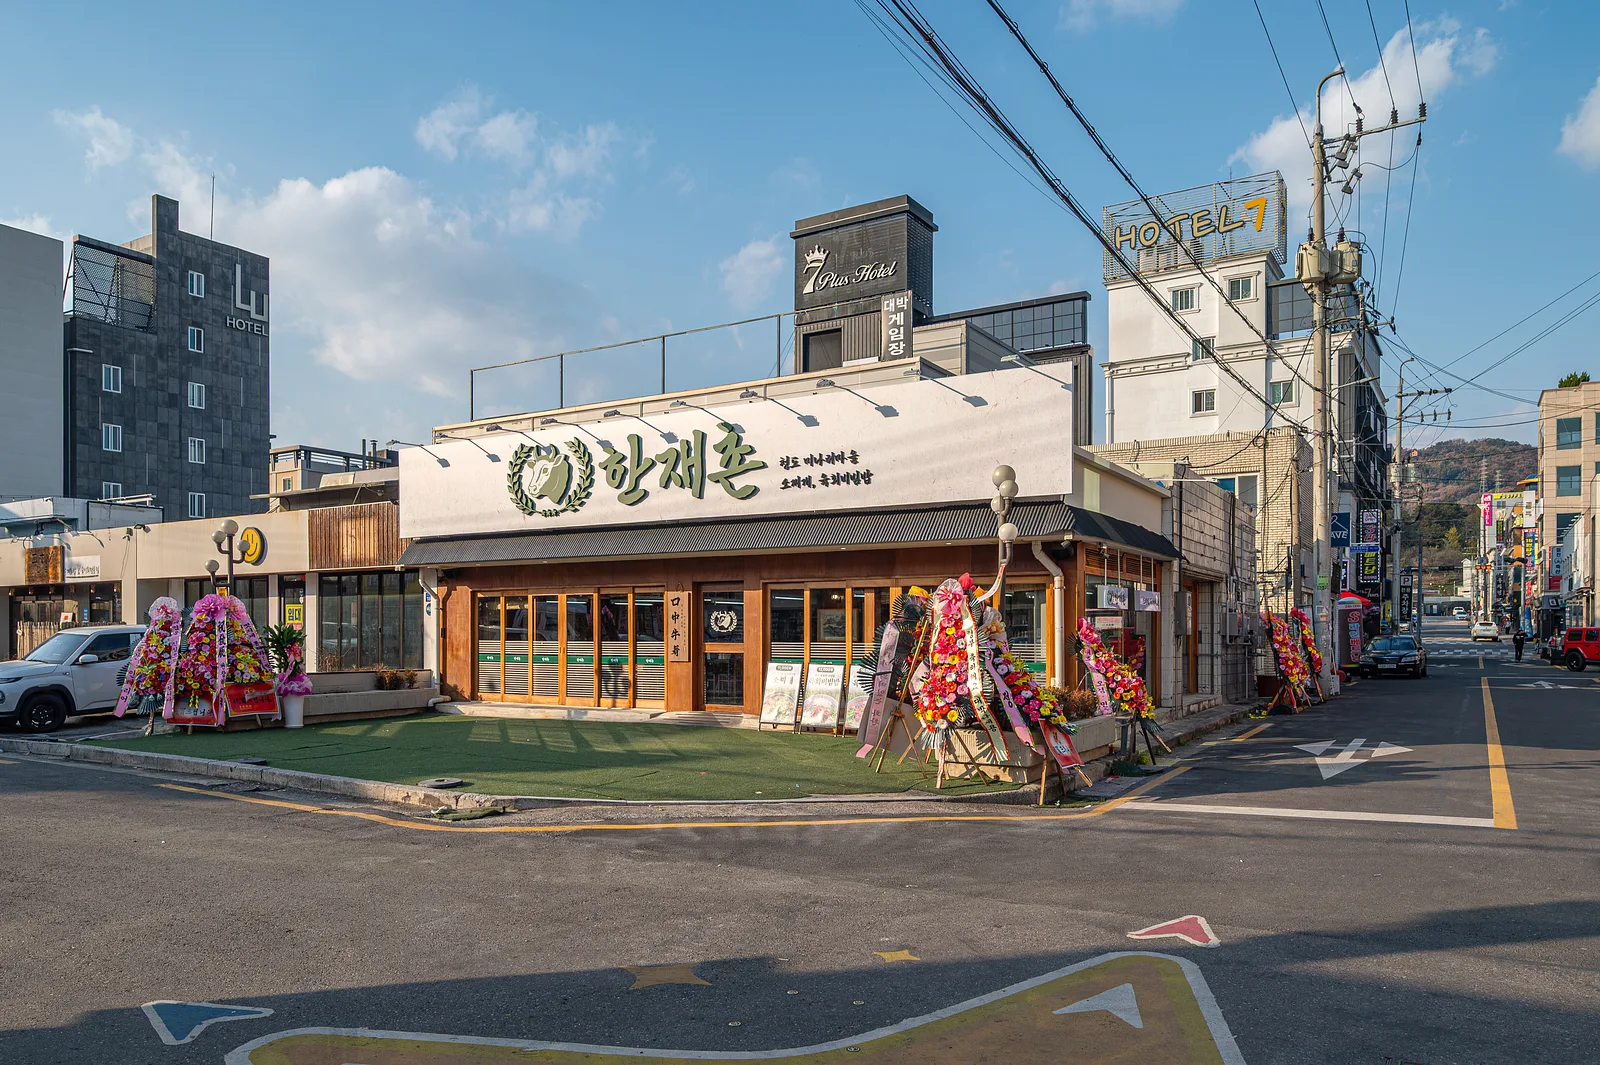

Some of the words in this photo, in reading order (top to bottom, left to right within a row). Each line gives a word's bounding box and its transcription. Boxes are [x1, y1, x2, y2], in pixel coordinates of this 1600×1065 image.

[1114, 205, 1244, 250] HOTEL
[1243, 196, 1267, 232] 7
[815, 271, 850, 291] Plus
[853, 261, 898, 284] Hotel
[883, 296, 908, 312] 대박
[226, 315, 269, 336] HOTEL
[887, 312, 905, 355] 게임장
[599, 422, 768, 505] 한재촌
[1330, 531, 1348, 539] AVE
[287, 607, 302, 621] 임대
